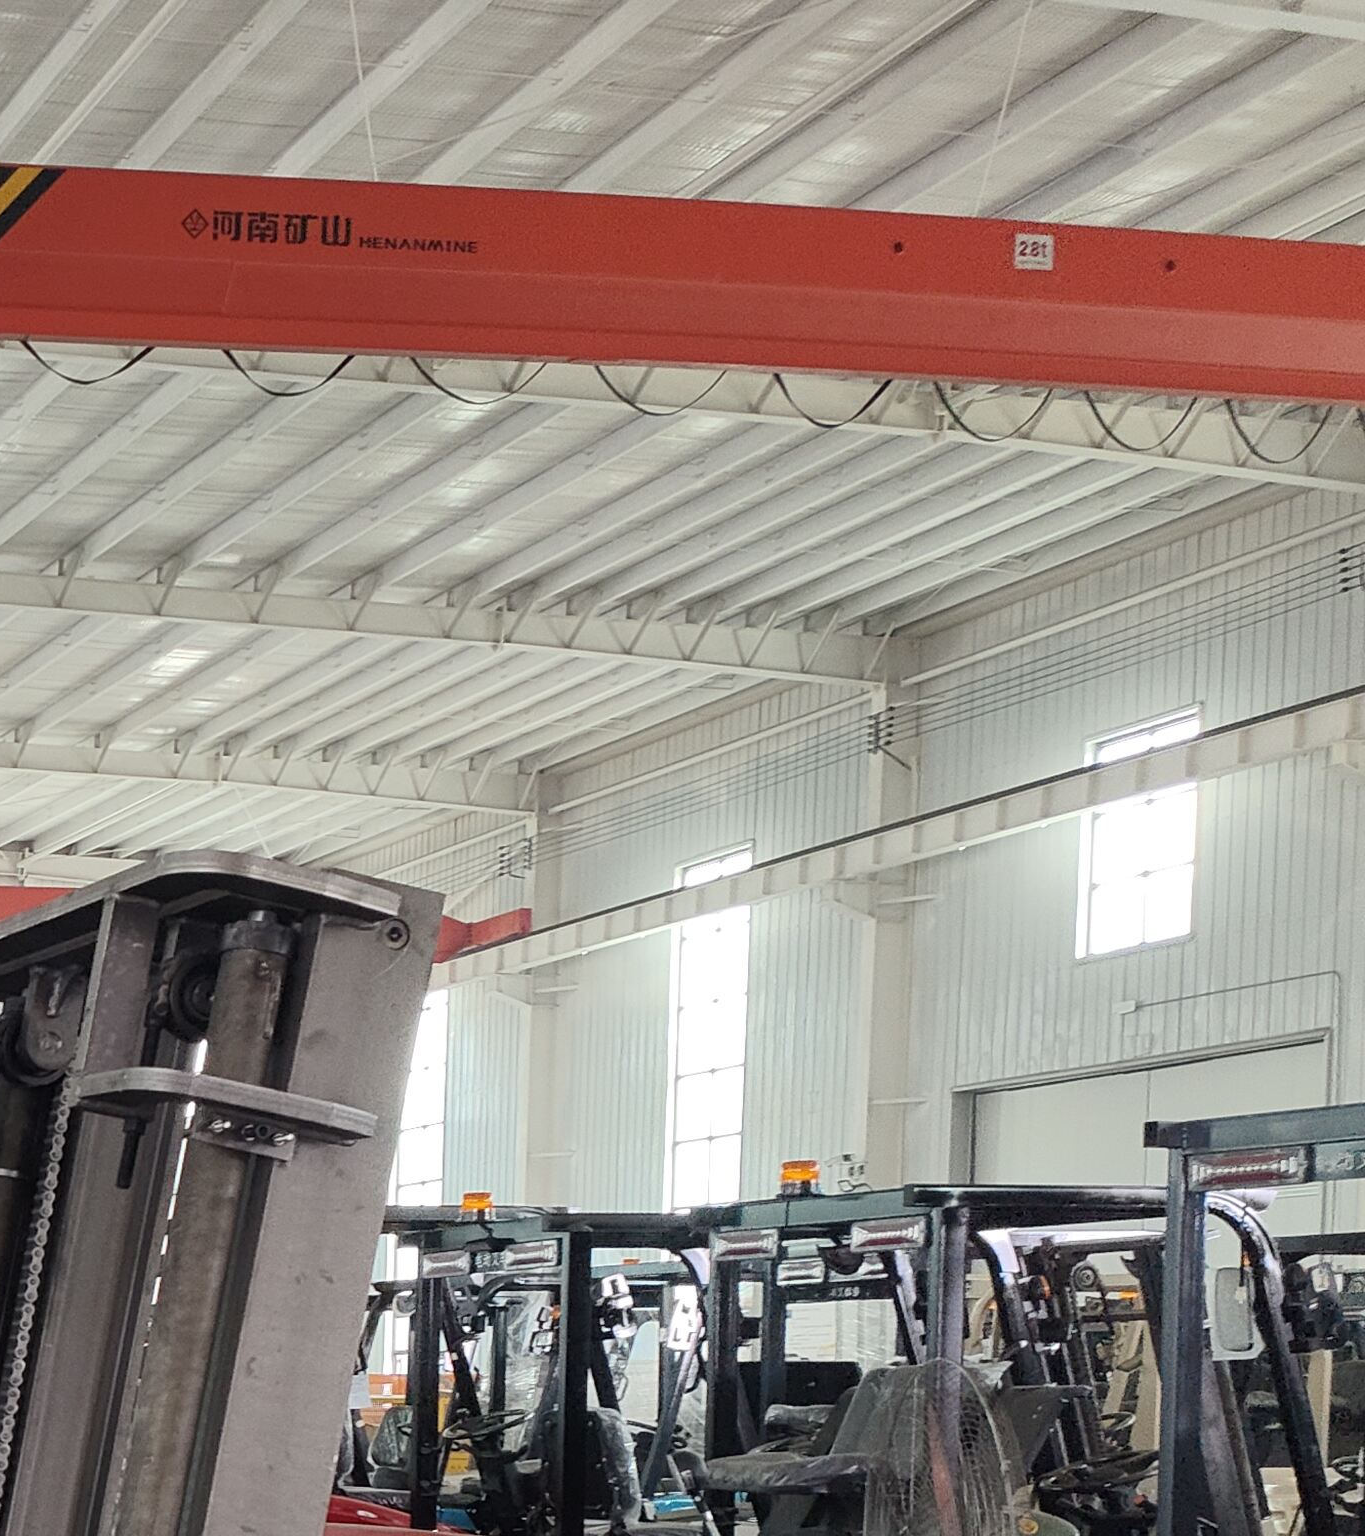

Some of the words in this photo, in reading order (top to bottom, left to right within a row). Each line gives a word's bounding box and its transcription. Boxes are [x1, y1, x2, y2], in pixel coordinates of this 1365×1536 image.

[212, 210, 352, 247] 河南矿山
[358, 236, 478, 254] HENANMINE
